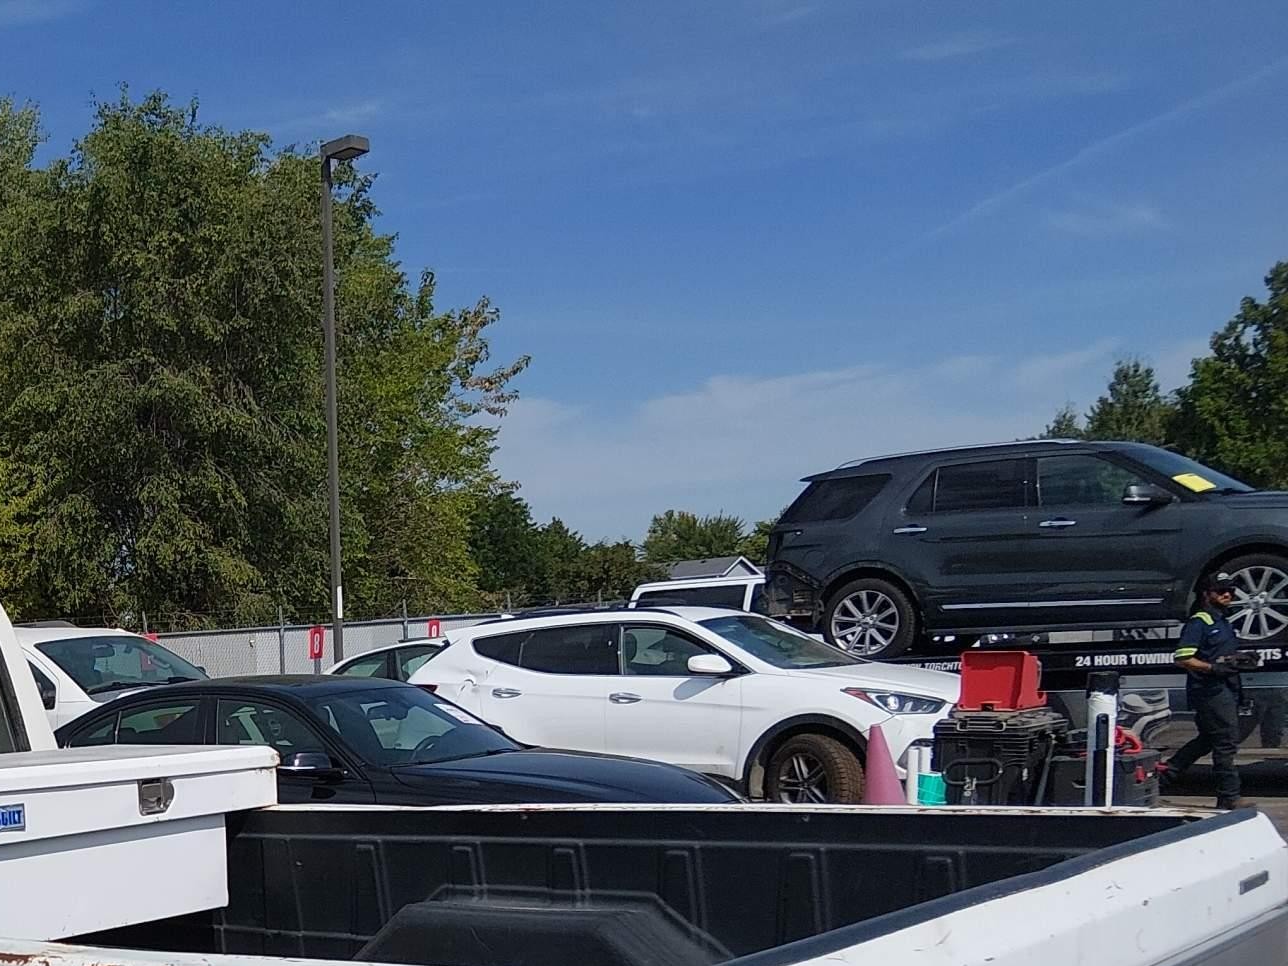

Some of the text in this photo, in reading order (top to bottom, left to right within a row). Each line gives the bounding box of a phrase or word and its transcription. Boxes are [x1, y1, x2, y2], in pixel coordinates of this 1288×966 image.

[313, 632, 321, 654] 8
[1075, 656, 1091, 667] 24
[1094, 655, 1127, 666] HOUR
